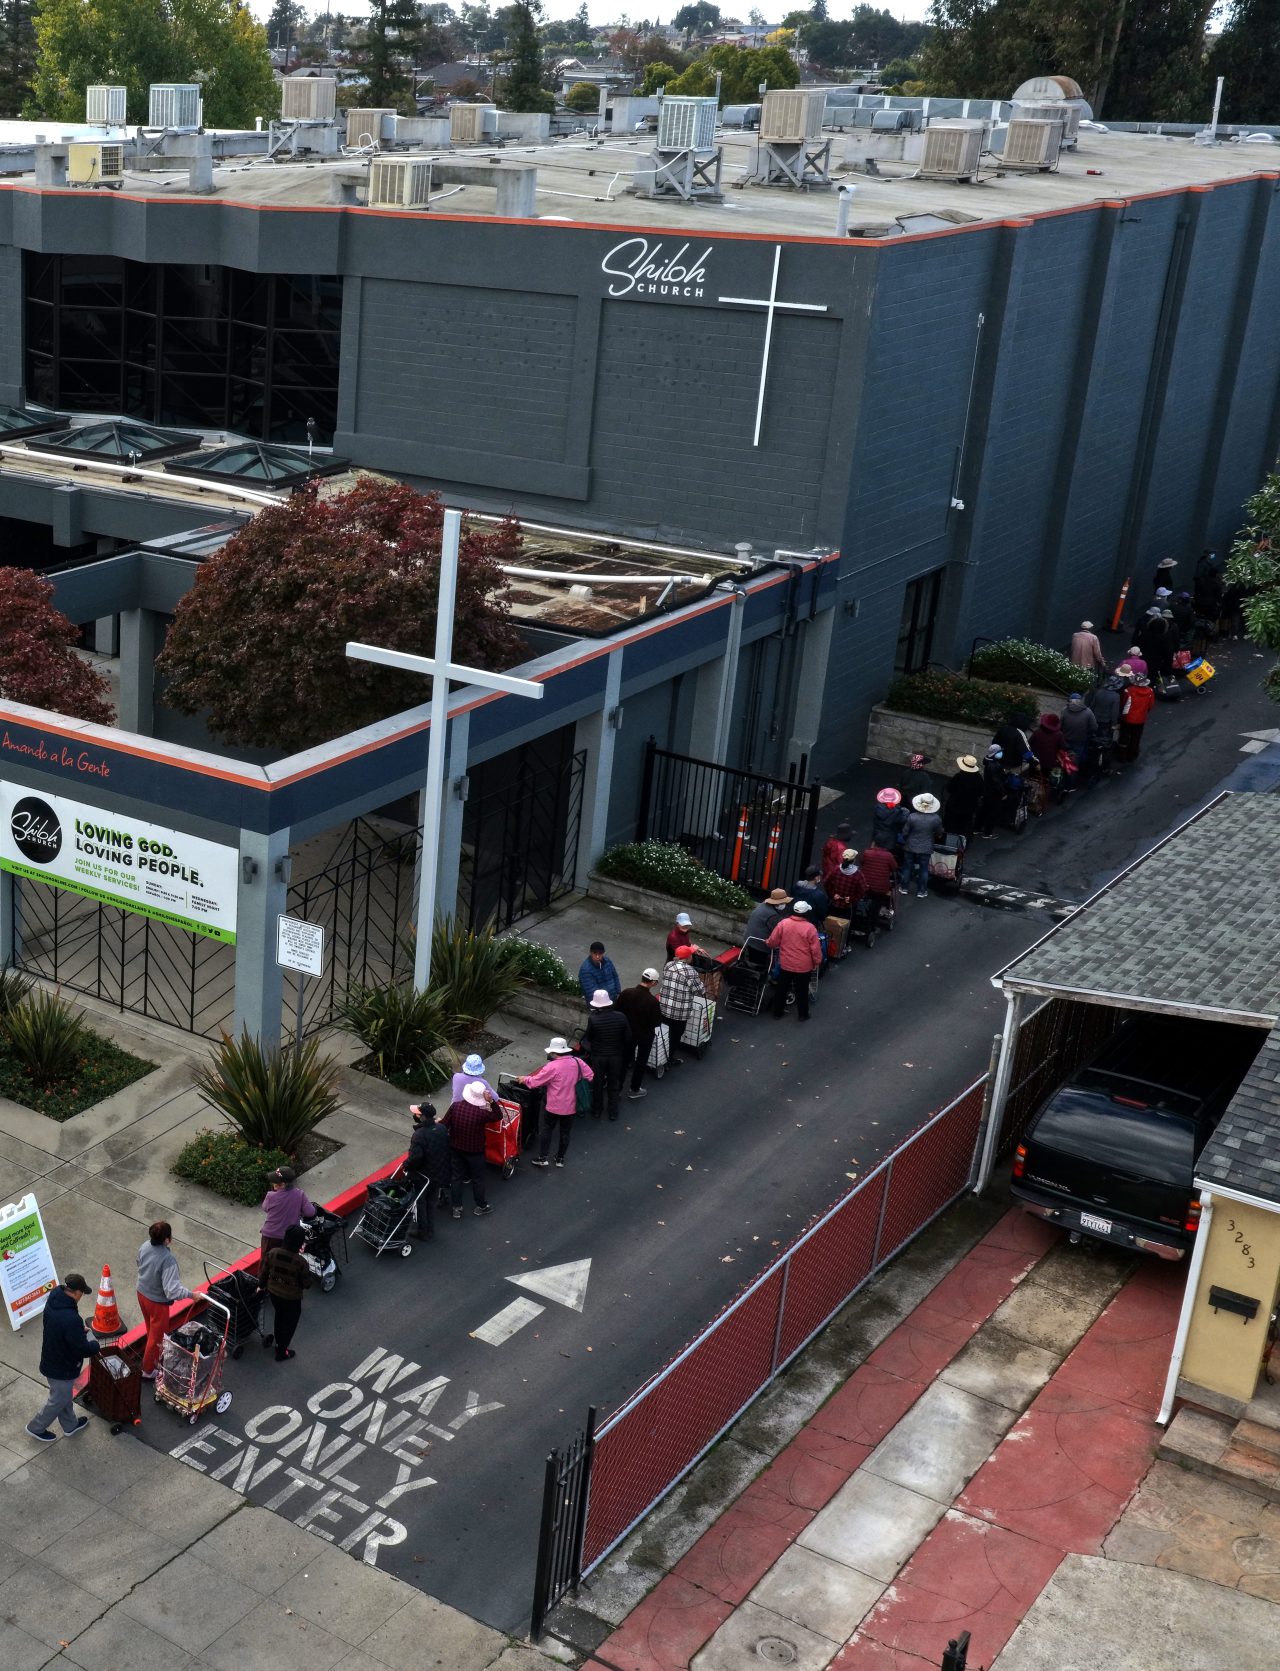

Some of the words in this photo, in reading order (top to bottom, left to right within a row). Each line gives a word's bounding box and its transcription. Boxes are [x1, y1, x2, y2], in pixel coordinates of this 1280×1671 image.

[601, 237, 713, 296] Shiloh
[637, 283, 704, 297] CHURCH
[2, 731, 49, 760] Amando
[50, 751, 59, 762] a
[61, 746, 74, 768] la
[77, 751, 111, 778] Gente
[11, 811, 62, 843] Shiloh
[27, 835, 58, 849] CHURCH
[75, 818, 133, 849] LOVING
[137, 837, 178, 860] GOD.
[74, 858, 91, 868] JOIN
[93, 862, 103, 871] US
[104, 866, 119, 877] FOR
[120, 870, 136, 882] OUR
[74, 865, 102, 879] WEEKLY
[103, 875, 140, 892] SERVICES!
[75, 836, 133, 866] LOVING
[137, 855, 205, 888] PEOPLE.
[23, 1220, 36, 1231] food
[1227, 1219, 1256, 1269] 3283
[347, 1346, 506, 1430] WAY
[306, 1382, 455, 1466] ONE
[243, 1405, 438, 1509] ONLY
[169, 1423, 408, 1566] ENTER
